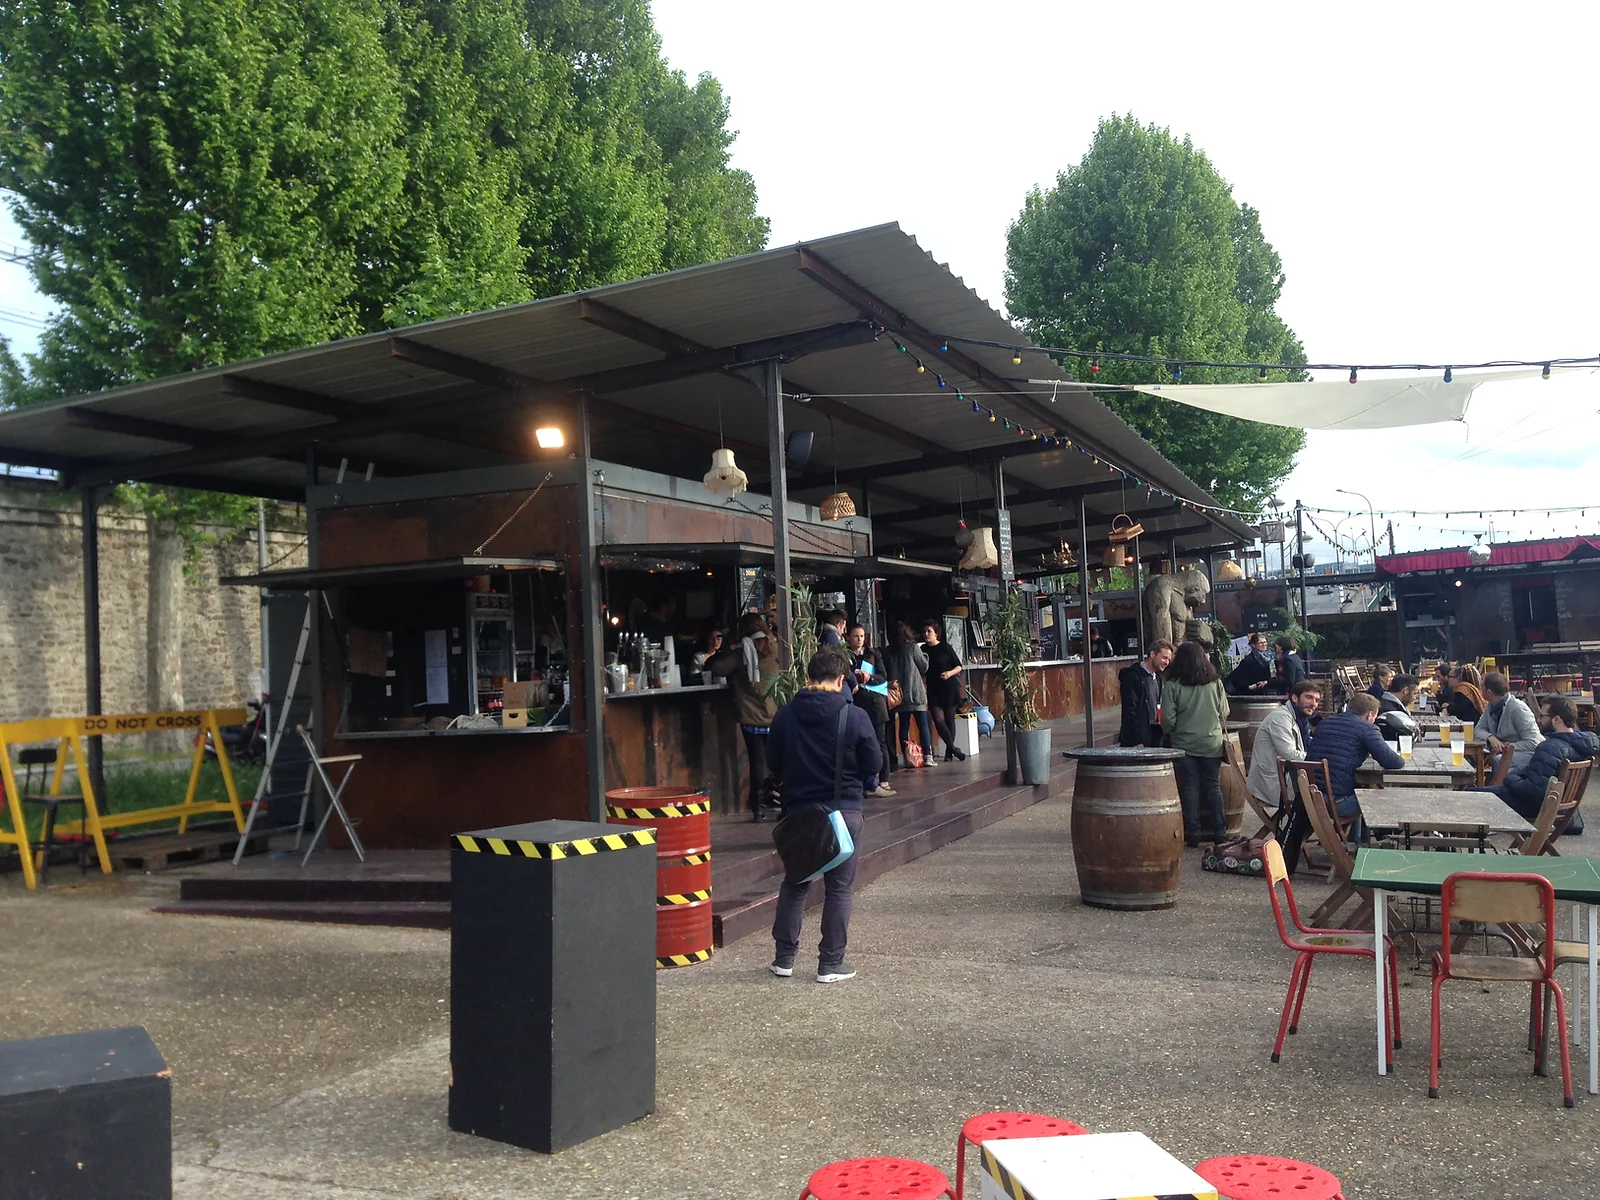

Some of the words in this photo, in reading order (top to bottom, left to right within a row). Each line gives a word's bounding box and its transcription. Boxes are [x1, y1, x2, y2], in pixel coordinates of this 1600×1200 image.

[85, 719, 108, 730] DO
[115, 717, 148, 729] NOT
[156, 715, 202, 728] CROSS
